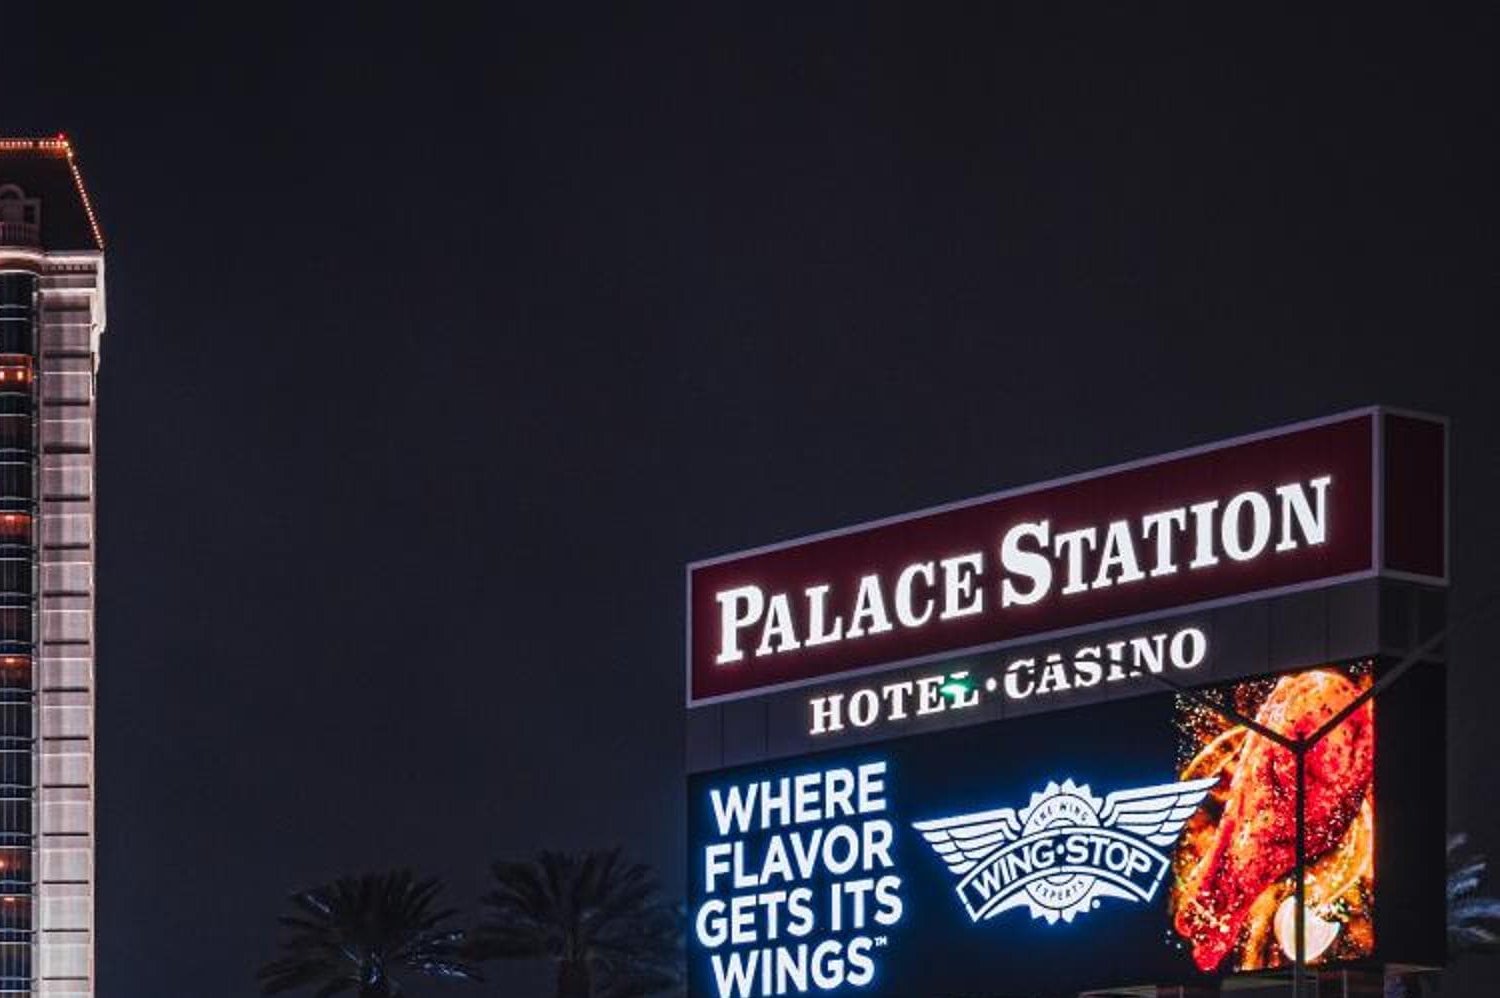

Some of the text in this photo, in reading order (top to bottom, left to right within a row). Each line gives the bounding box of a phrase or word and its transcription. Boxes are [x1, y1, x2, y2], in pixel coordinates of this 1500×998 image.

[715, 476, 1332, 666] PALACE STATION
[809, 628, 1208, 736] HOTEL CASINO
[710, 761, 887, 837] WHERE
[705, 819, 895, 893] FLAVOR
[695, 875, 904, 948] GETS ITS
